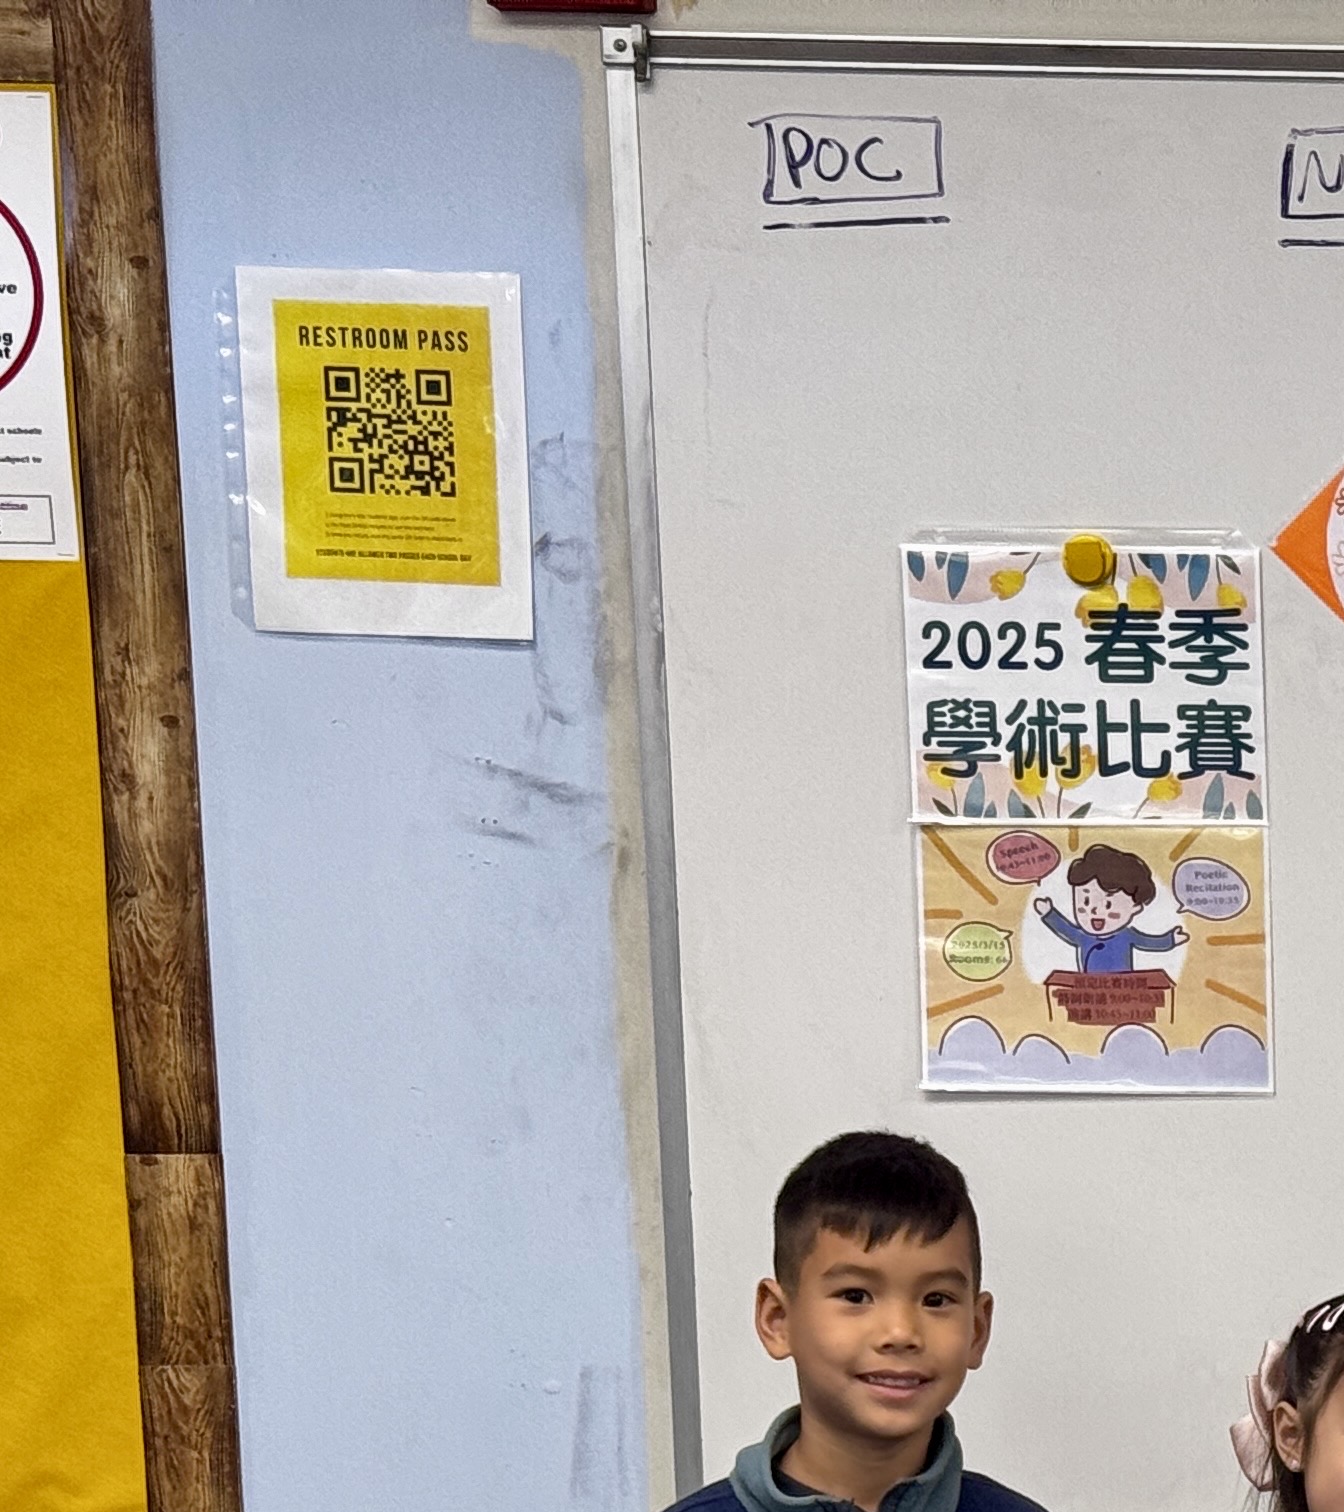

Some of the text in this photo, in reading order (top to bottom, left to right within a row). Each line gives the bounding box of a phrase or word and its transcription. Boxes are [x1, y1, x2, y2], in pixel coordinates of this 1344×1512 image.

[782, 126, 903, 190] POC
[298, 325, 469, 353] RESTROOM PASS
[921, 602, 1251, 687] 2025 春季
[922, 697, 1257, 781] 學術比賽
[1185, 883, 1240, 892] Recitation
[1194, 870, 1228, 880] Poetic
